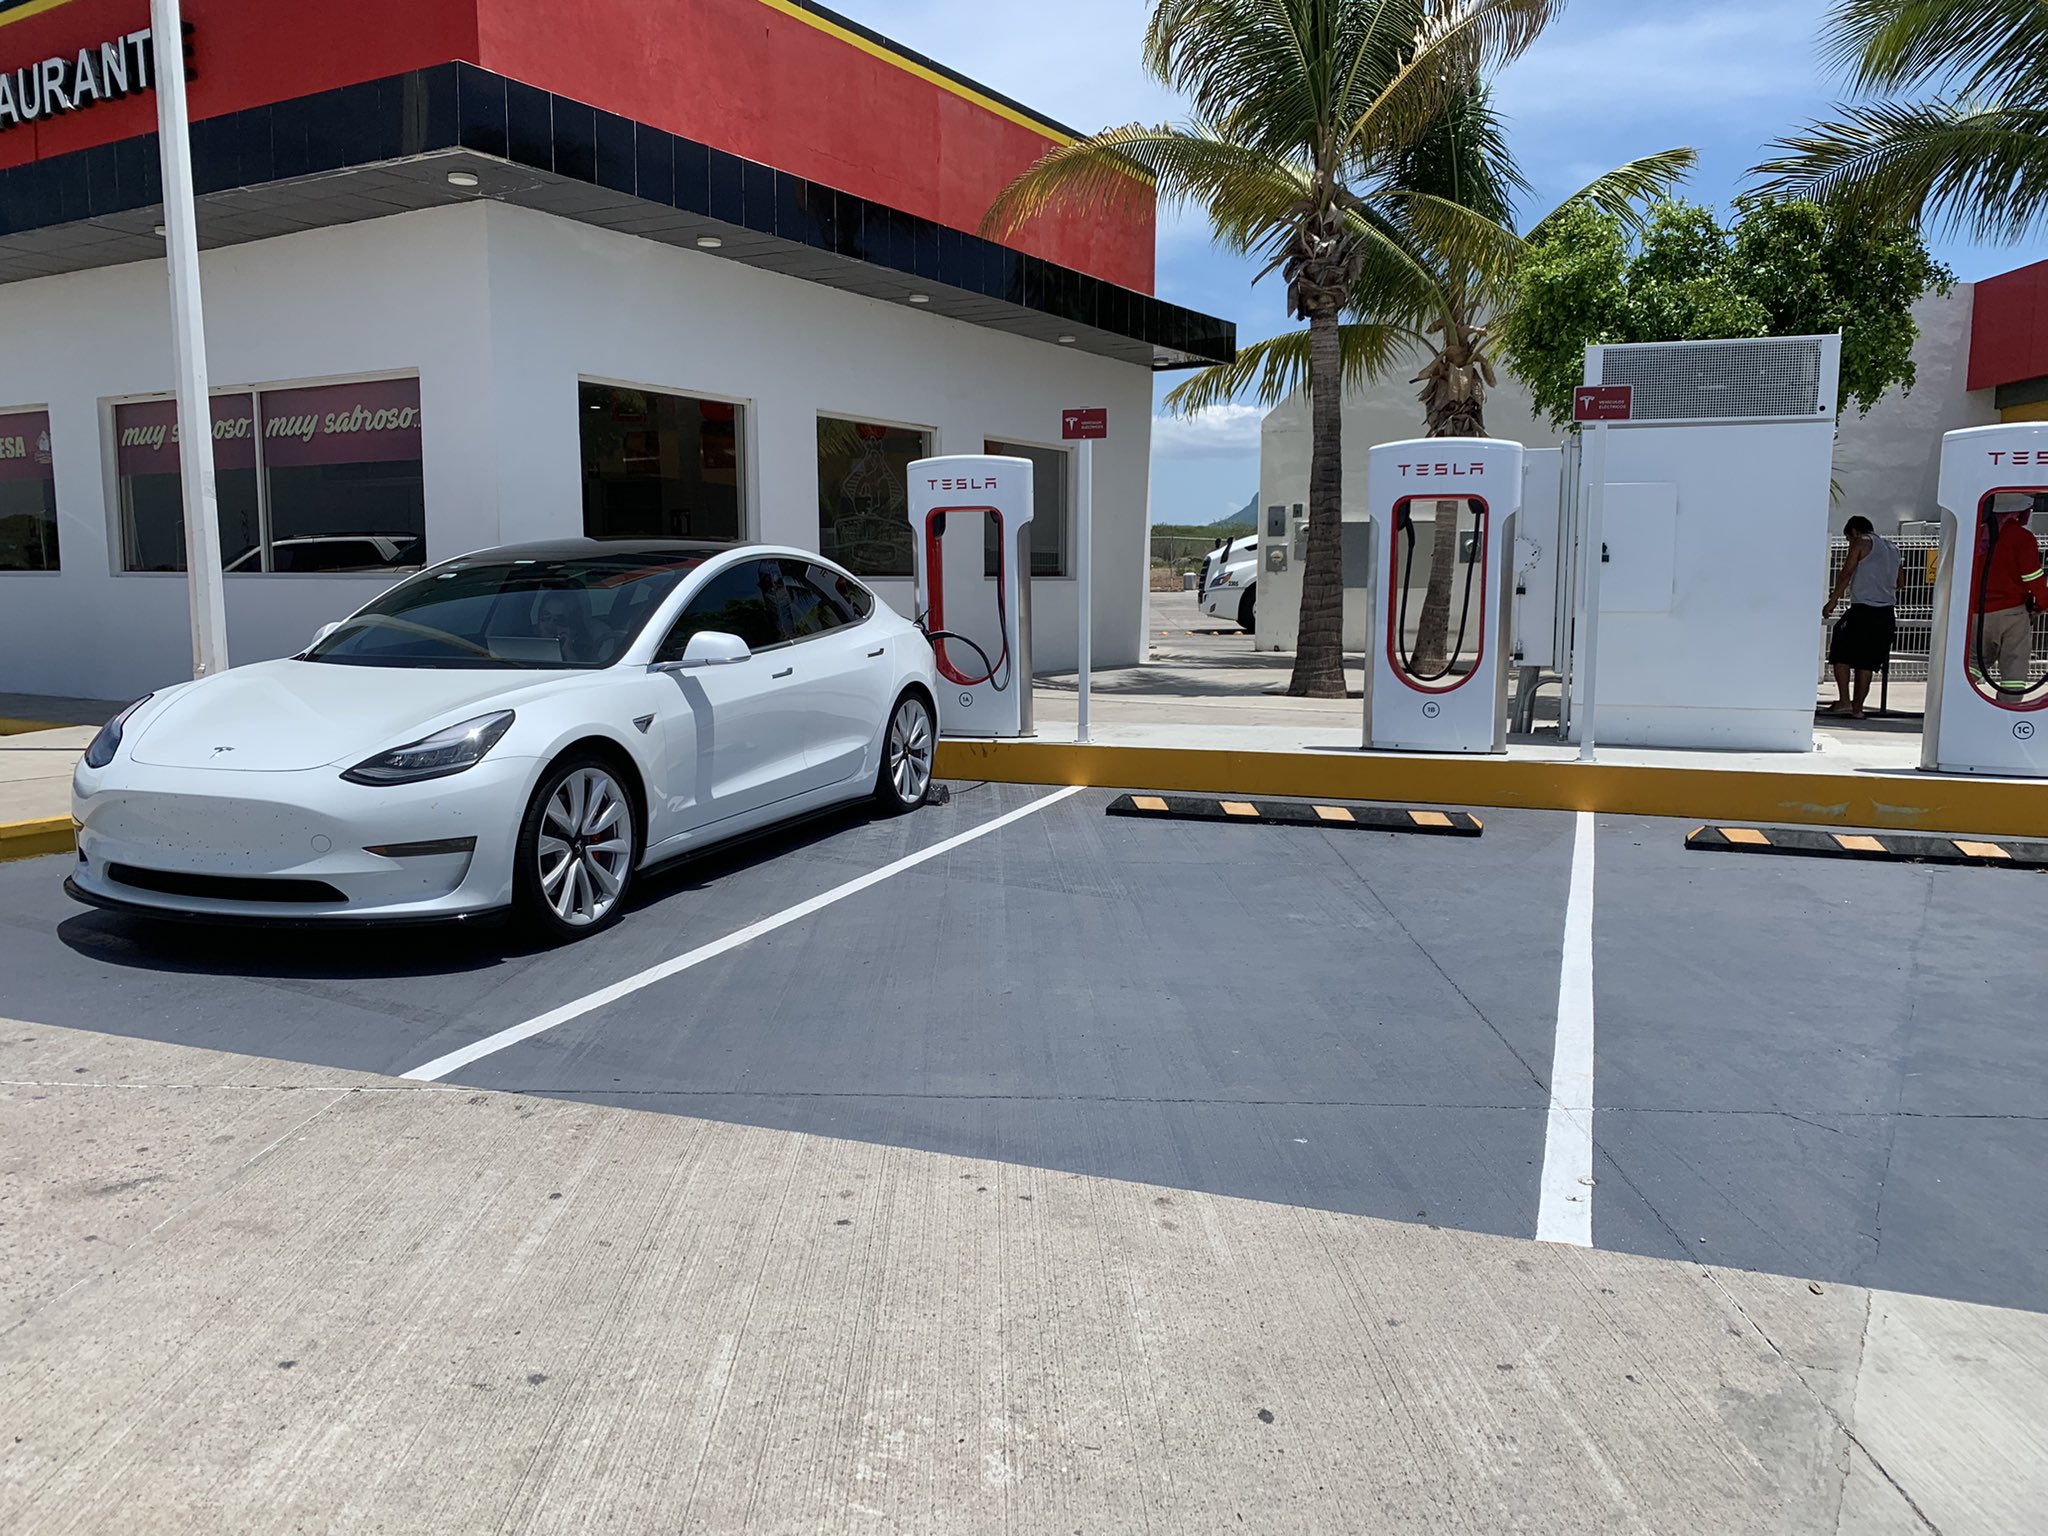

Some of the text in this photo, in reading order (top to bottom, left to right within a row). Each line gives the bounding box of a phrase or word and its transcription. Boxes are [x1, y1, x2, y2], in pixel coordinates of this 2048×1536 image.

[0, 28, 152, 122] AURANT
[121, 424, 166, 450] muy
[265, 413, 319, 443] muy
[1397, 462, 1484, 477] TESLA
[927, 477, 997, 491] TESLA
[2017, 726, 2030, 734] 1C
